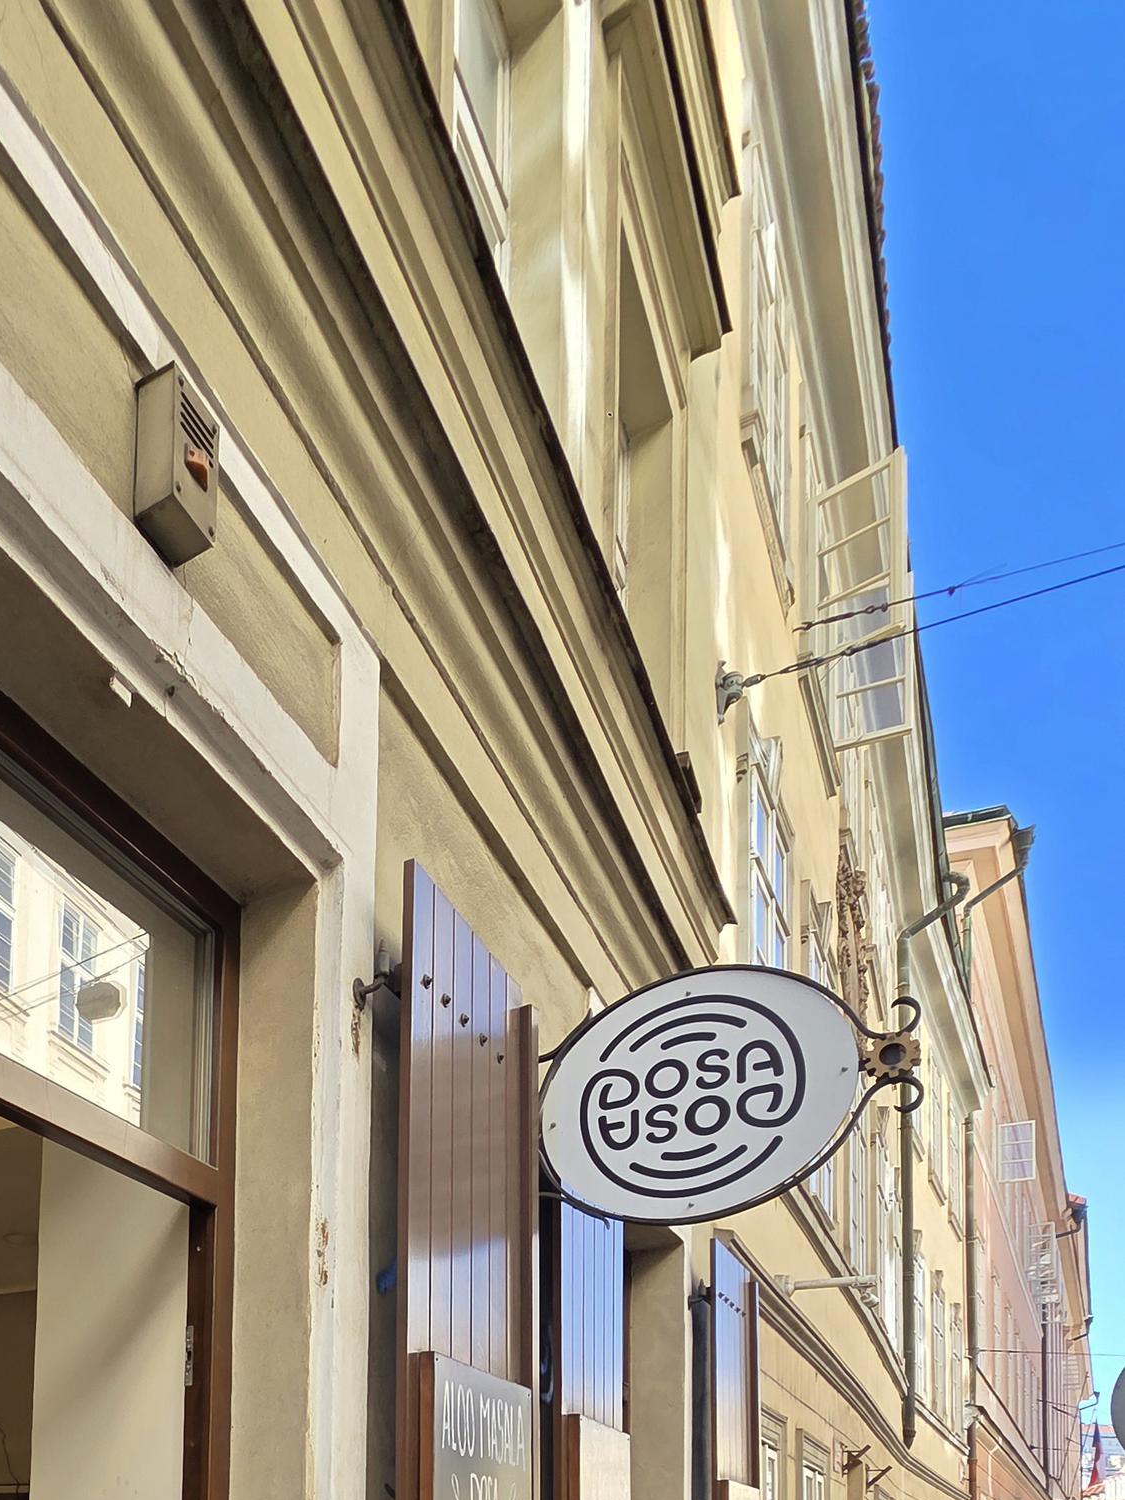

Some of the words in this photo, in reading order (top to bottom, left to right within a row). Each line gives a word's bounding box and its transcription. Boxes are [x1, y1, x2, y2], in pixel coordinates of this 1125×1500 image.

[588, 1038, 784, 1111] DOSA
[441, 1379, 475, 1457] ALOO
[479, 1392, 526, 1472] MASALA
